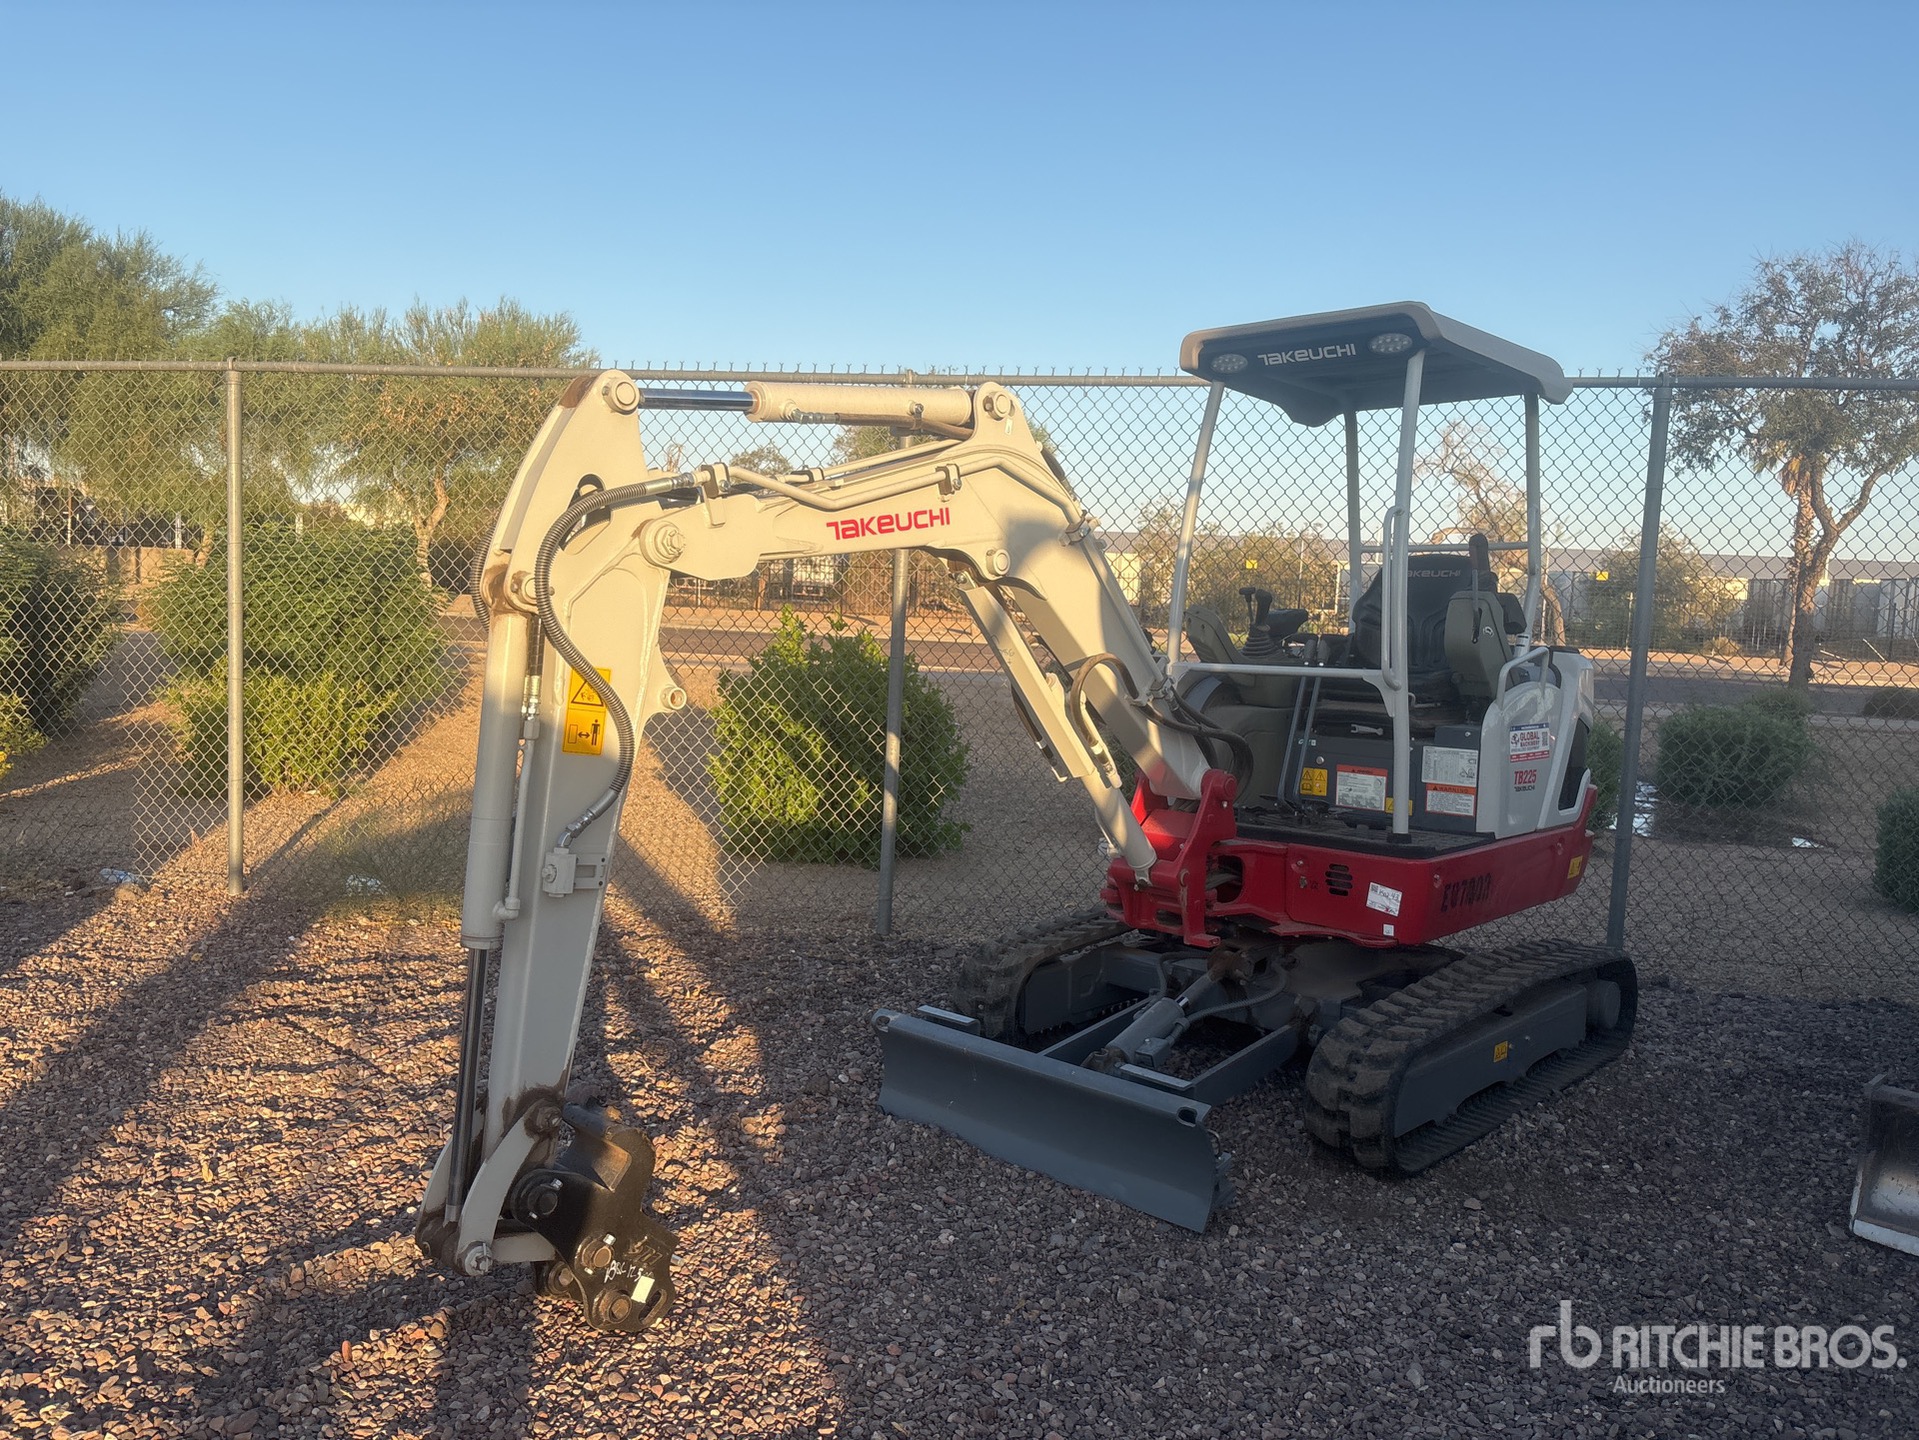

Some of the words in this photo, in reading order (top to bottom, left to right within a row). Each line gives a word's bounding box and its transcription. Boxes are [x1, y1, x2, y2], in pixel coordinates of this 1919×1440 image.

[1257, 343, 1357, 366] TAKEUCHI
[826, 507, 950, 540] TAKEUCHI
[1407, 569, 1461, 578] AKEUCHI
[1514, 769, 1537, 785] TB225
